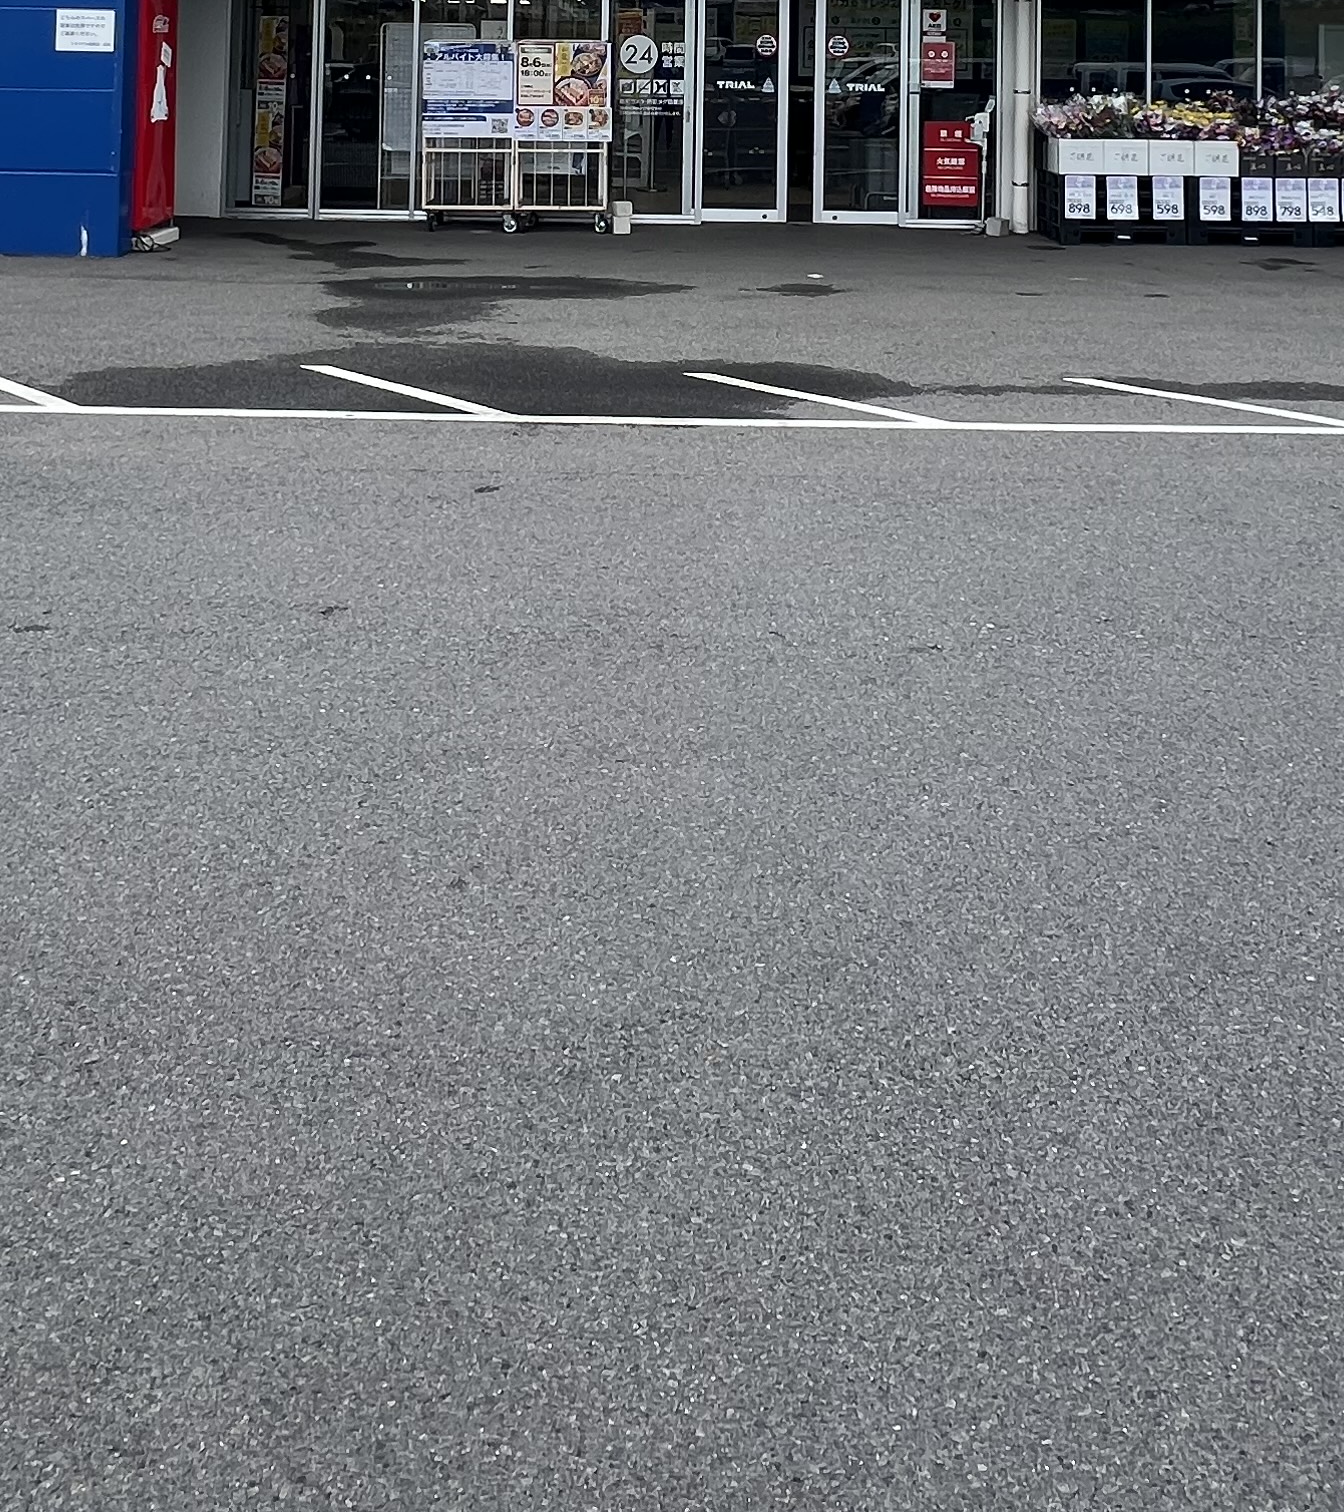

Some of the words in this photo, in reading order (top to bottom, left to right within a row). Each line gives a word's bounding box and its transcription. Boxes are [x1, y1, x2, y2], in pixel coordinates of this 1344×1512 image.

[661, 42, 686, 54] 時間
[624, 44, 654, 65] 24
[717, 80, 755, 89] TRIAL
[846, 83, 885, 92] TRIAL
[1068, 202, 1091, 214] 898
[1110, 203, 1133, 214] 698
[1157, 203, 1179, 214] 598
[1203, 205, 1226, 216] 598
[1245, 205, 1268, 217] 898
[1279, 206, 1302, 217] 798
[1311, 205, 1335, 216] 548
